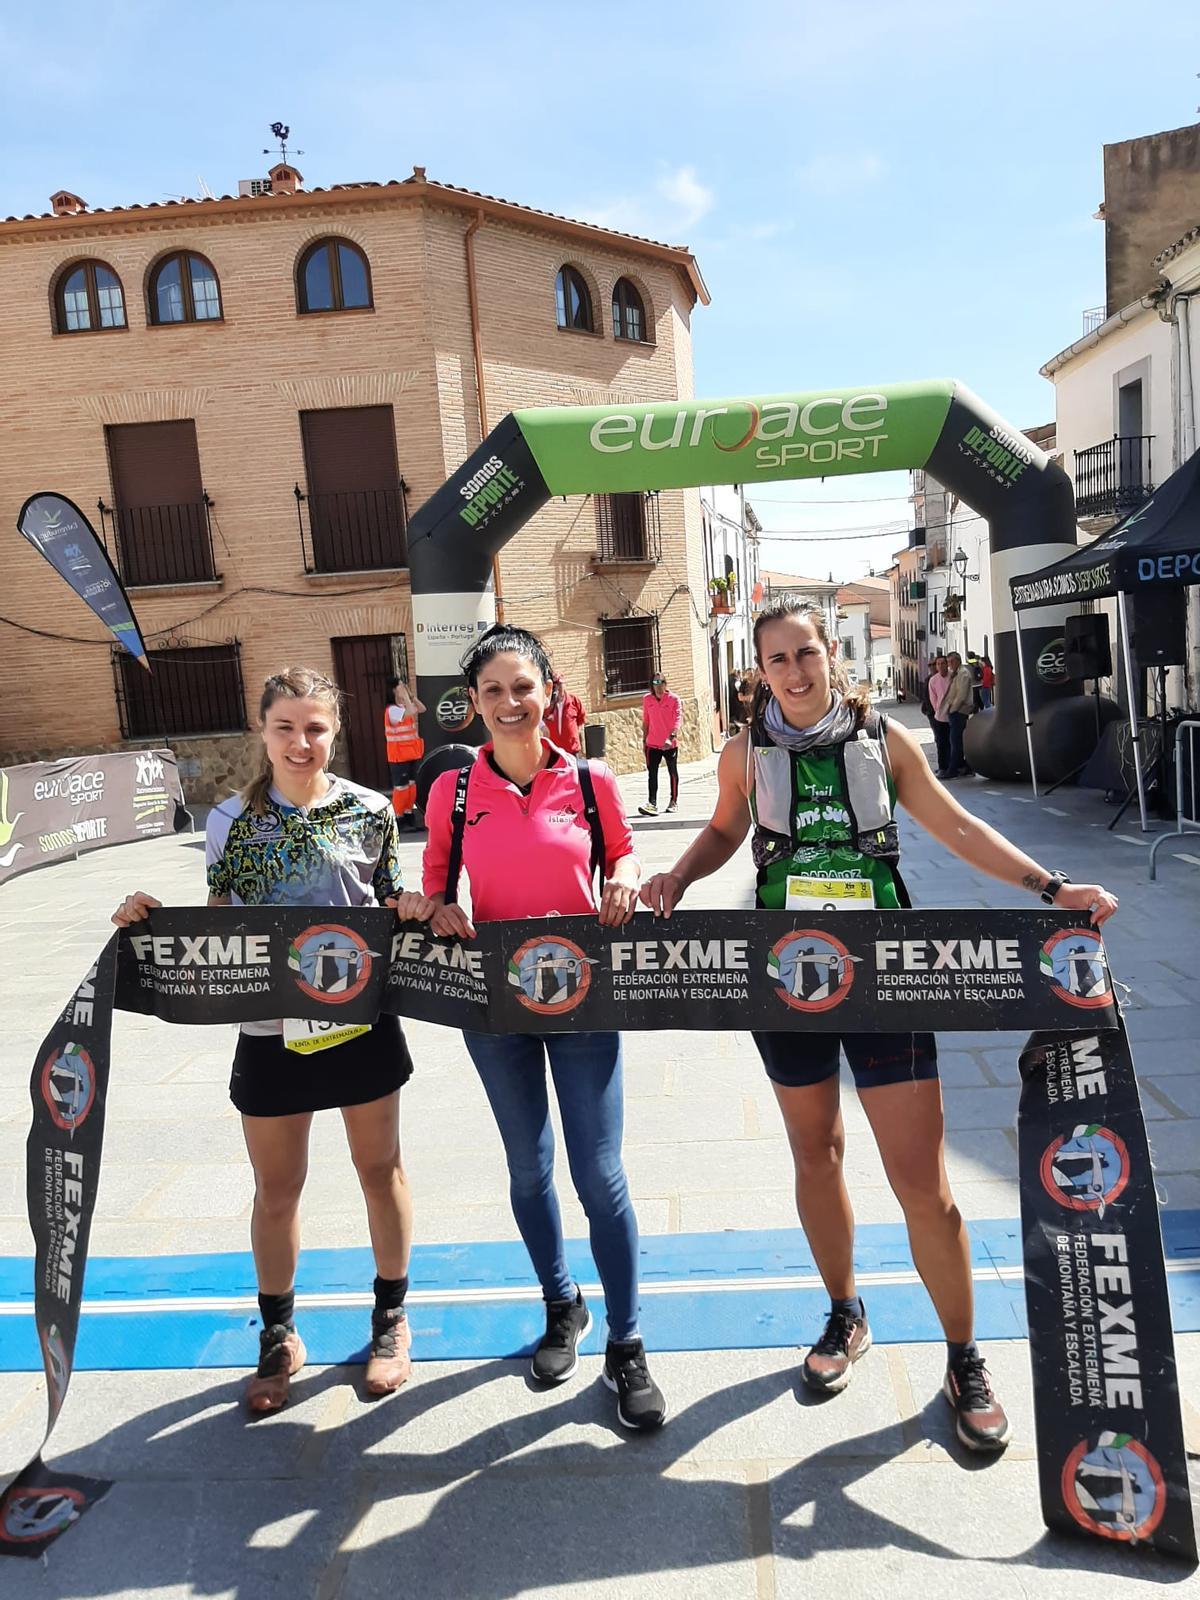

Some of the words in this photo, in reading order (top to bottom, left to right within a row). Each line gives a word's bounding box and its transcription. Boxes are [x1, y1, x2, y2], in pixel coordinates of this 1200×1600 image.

[756, 433, 889, 469] SPORT
[963, 425, 1028, 481] DEPORTE
[459, 465, 520, 526] DEPORTE
[1075, 562, 1111, 592] DEPORTE
[427, 623, 474, 633] Interreg
[437, 701, 468, 715] ea
[69, 789, 105, 806] SPORT
[455, 789, 466, 813] FILA
[130, 934, 271, 966] FEXME
[610, 939, 749, 971] FEXME
[875, 939, 1023, 970] FEXME
[138, 963, 196, 981] FEDERACIÓN
[201, 966, 271, 982] EXTREMEÑA
[140, 978, 153, 988] DE
[199, 984, 206, 995] Y
[208, 981, 271, 996] ESCALADA
[613, 971, 678, 986] FEDERACIÓN
[682, 970, 749, 985] EXTREMEÑA
[877, 971, 949, 986] FEDERACIÓN
[955, 970, 1025, 985] EXTREMEÑA
[434, 983, 442, 993] Y
[443, 985, 489, 1005] ESCALADA
[613, 988, 627, 1000] DE
[629, 986, 681, 1000] MONTAÑA
[682, 988, 689, 999] Y
[690, 987, 749, 999] ESCALADA
[877, 989, 893, 1001] DE
[895, 986, 952, 1001] MONTAÑA
[954, 988, 961, 999] Y
[964, 988, 1026, 1000] ESCALADA
[1045, 1050, 1059, 1105] ESCALADA
[45, 1148, 53, 1163] DE
[44, 1164, 54, 1219] MONTAÑA
[54, 1149, 64, 1221] FEDERACIÓN
[58, 1150, 84, 1305] FEXME
[45, 1229, 56, 1290] ESCALADA
[50, 1223, 65, 1294] EXTREMEÑA
[1056, 1235, 1071, 1253] DE
[1058, 1254, 1084, 1319] MONTAÑA
[1074, 1234, 1095, 1317] FEDERACIÓN
[1064, 1321, 1081, 1330] Y
[1090, 1233, 1144, 1409] FEXME
[1065, 1332, 1084, 1406] ESCALADA
[1082, 1323, 1103, 1407] EXTREMEÑA
